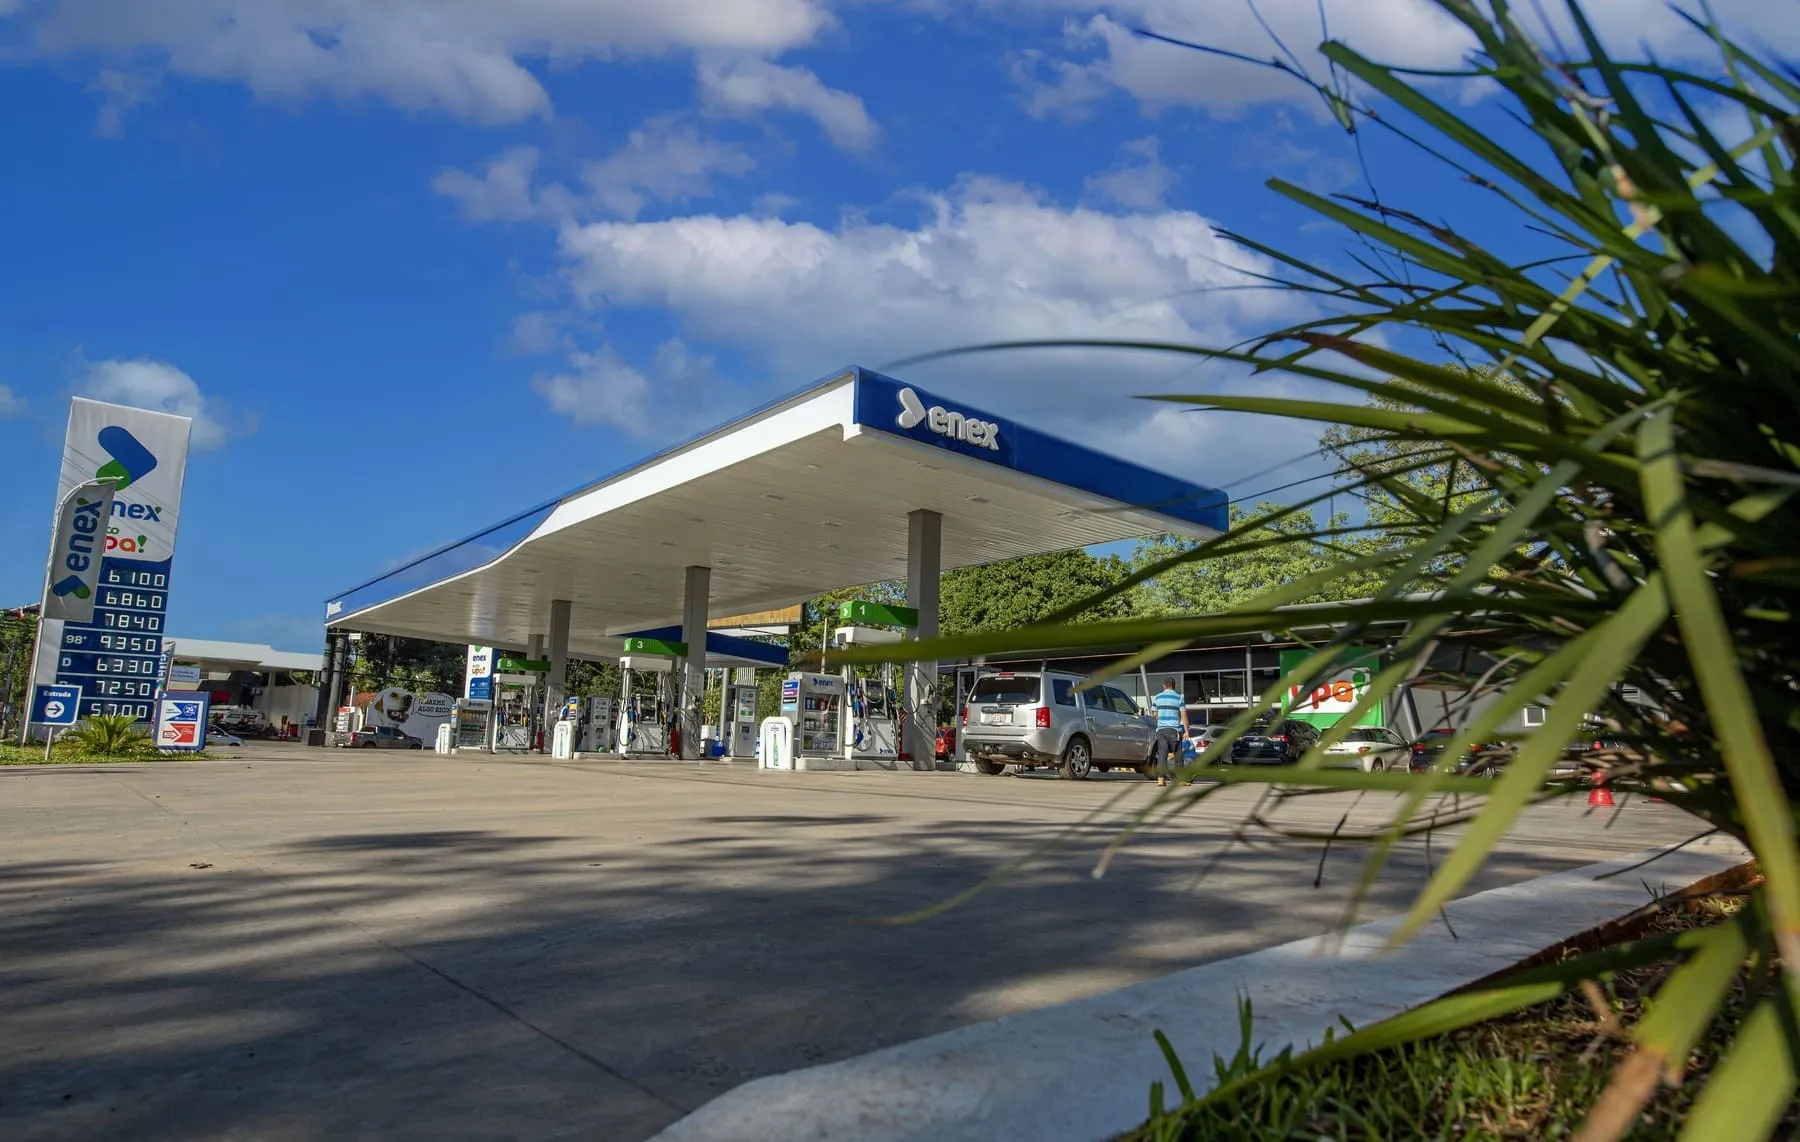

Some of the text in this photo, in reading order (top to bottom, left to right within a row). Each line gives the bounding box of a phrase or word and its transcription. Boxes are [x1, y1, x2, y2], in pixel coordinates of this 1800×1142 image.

[927, 405, 999, 451] enex
[110, 500, 161, 522] nex
[66, 498, 102, 571] enex
[104, 534, 147, 553] pa!
[109, 570, 165, 587] 6100
[106, 591, 162, 609] 6860
[859, 605, 865, 615] 1
[105, 613, 159, 630] 7840
[100, 635, 156, 652] 9350
[62, 658, 153, 674] D 6330
[43, 690, 71, 698] Entrada
[96, 680, 150, 696] 7250
[91, 703, 147, 719] 5700
